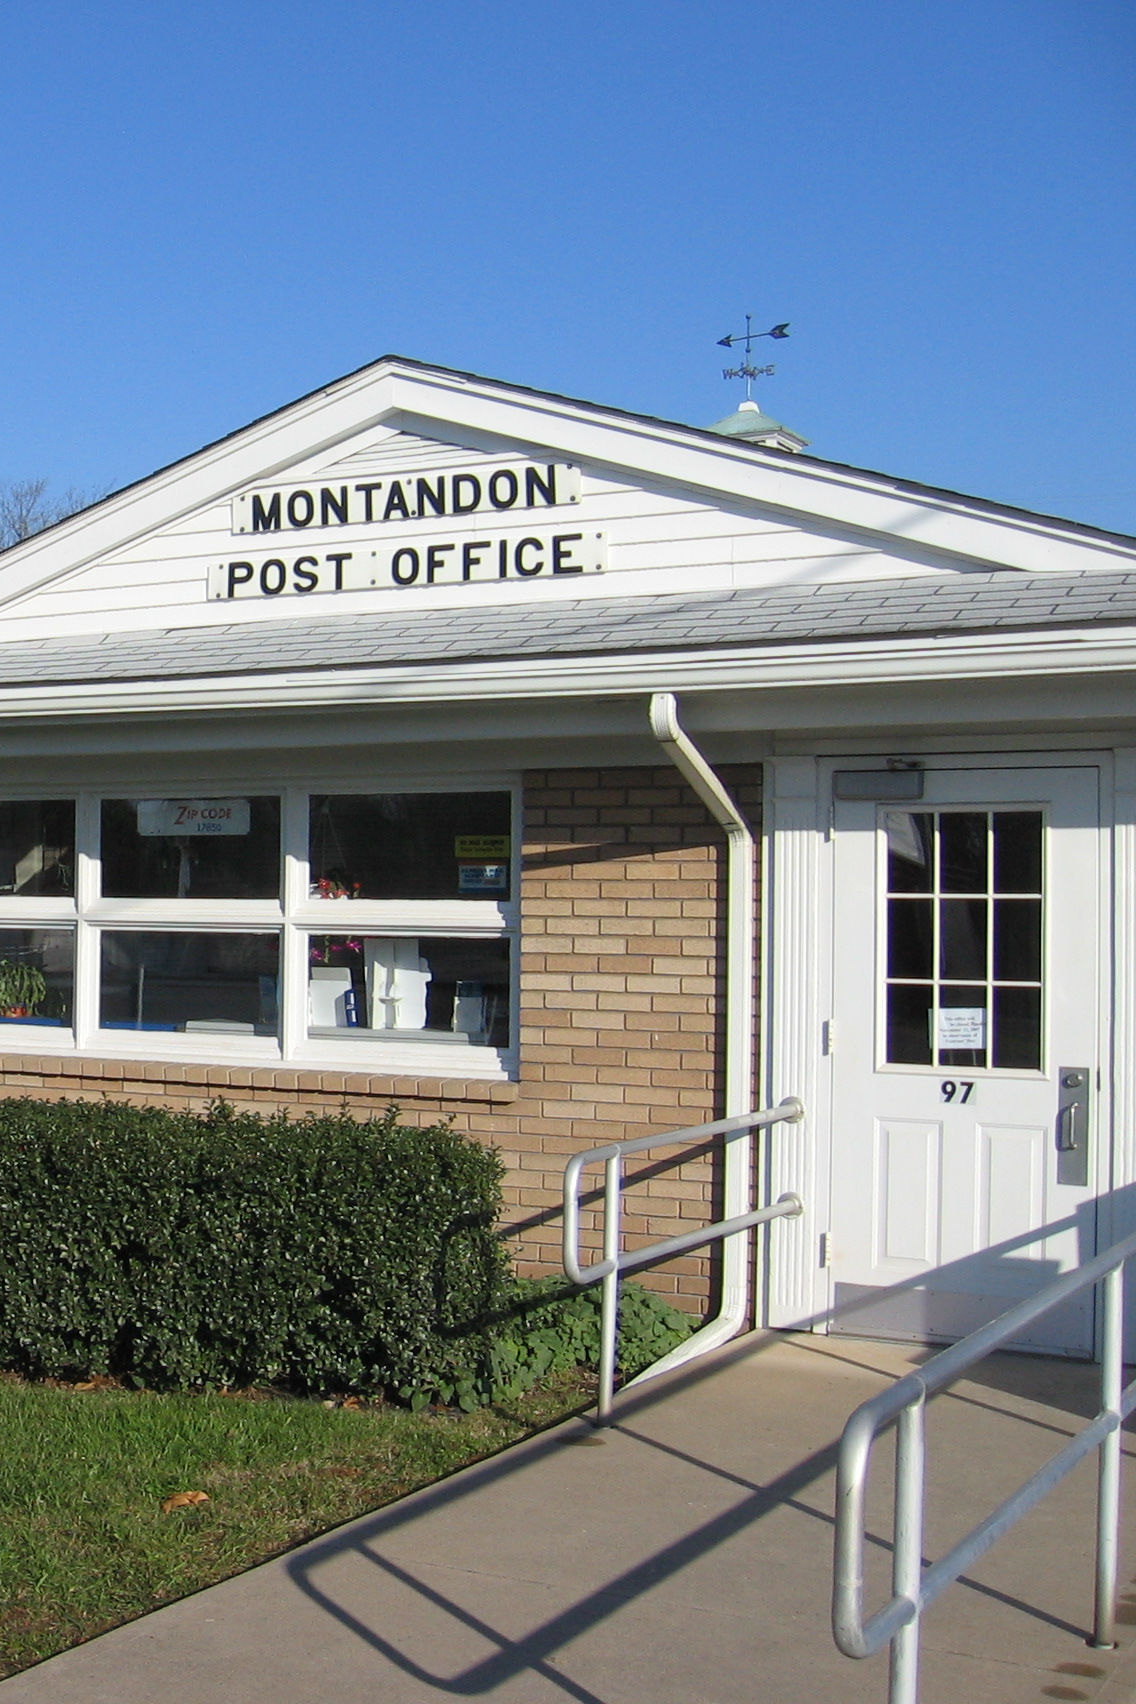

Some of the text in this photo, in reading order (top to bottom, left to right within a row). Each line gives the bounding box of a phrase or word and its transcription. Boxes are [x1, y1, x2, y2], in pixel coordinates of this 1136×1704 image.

[766, 365, 775, 376] E
[252, 464, 557, 533] MONTANDON
[227, 534, 583, 599] POST OFFICE
[201, 809, 232, 819] CODE
[198, 823, 222, 832] 17850
[941, 1081, 974, 1104] 97
